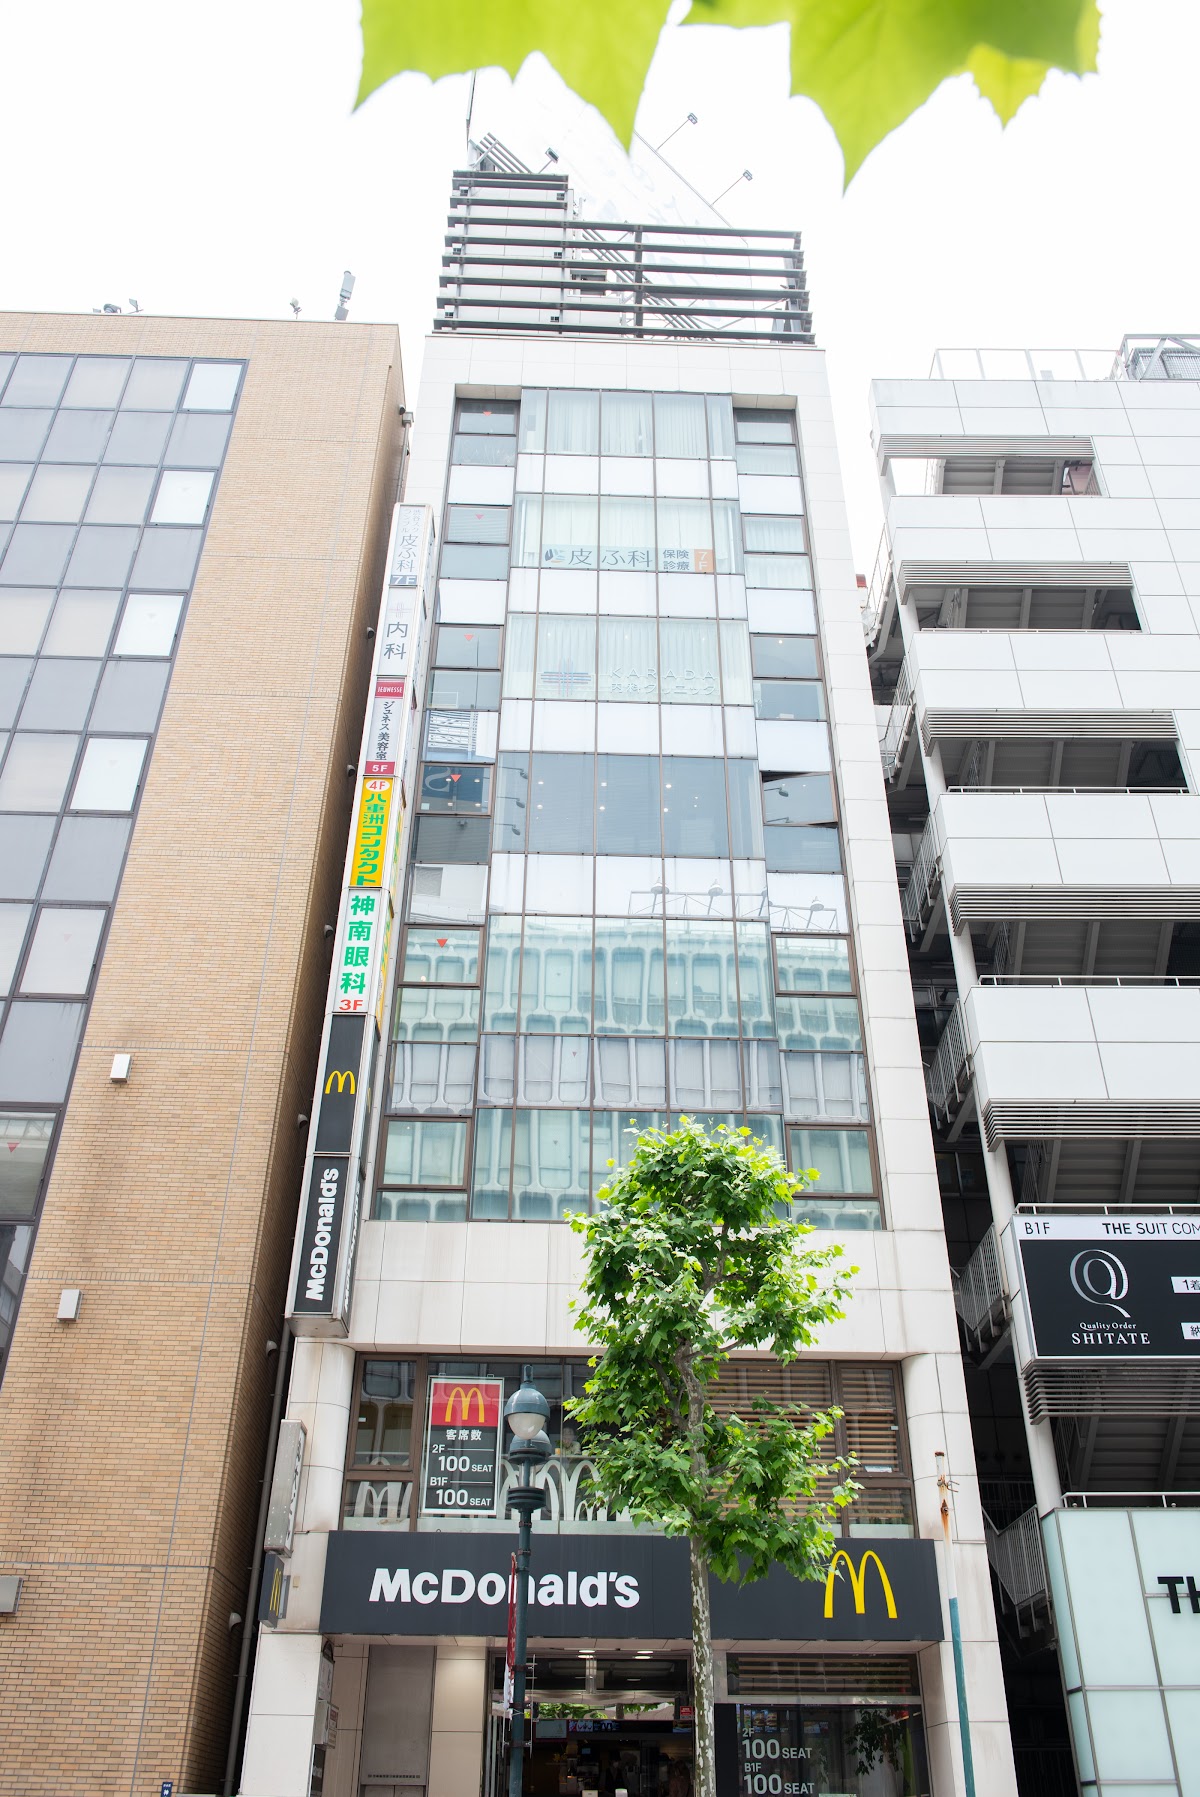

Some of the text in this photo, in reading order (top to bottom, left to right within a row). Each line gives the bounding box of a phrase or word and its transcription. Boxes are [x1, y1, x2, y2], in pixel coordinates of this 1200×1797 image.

[397, 534, 418, 573] 皮ふ科
[567, 547, 690, 567] 皮ふ科 保険
[662, 560, 690, 571] 診療
[392, 575, 417, 586] 7F
[383, 621, 409, 660] 内科
[610, 667, 716, 681] KARADA
[371, 764, 389, 773] 5F
[368, 780, 386, 791] 4F
[356, 793, 387, 886] 八重洲コンタクト
[339, 895, 376, 995] 神南眼科
[339, 999, 364, 1011] 3F
[305, 1167, 340, 1301] McDonald's
[1024, 1222, 1051, 1235] B1F
[1102, 1222, 1133, 1235] THE
[1136, 1222, 1168, 1235] SUIT
[1079, 1321, 1137, 1331] Quality Order
[1071, 1332, 1151, 1345] SHITATE
[445, 1429, 482, 1441] 客席数
[432, 1444, 445, 1454] 2F
[438, 1455, 494, 1473] 100 SEAT
[430, 1476, 448, 1486] B1F
[435, 1488, 492, 1507] 100 SEAT
[742, 1727, 755, 1737] 2F
[742, 1739, 813, 1759] 100 SEAT
[744, 1762, 762, 1772] B1F
[743, 1774, 815, 1795] 100 SEAT
